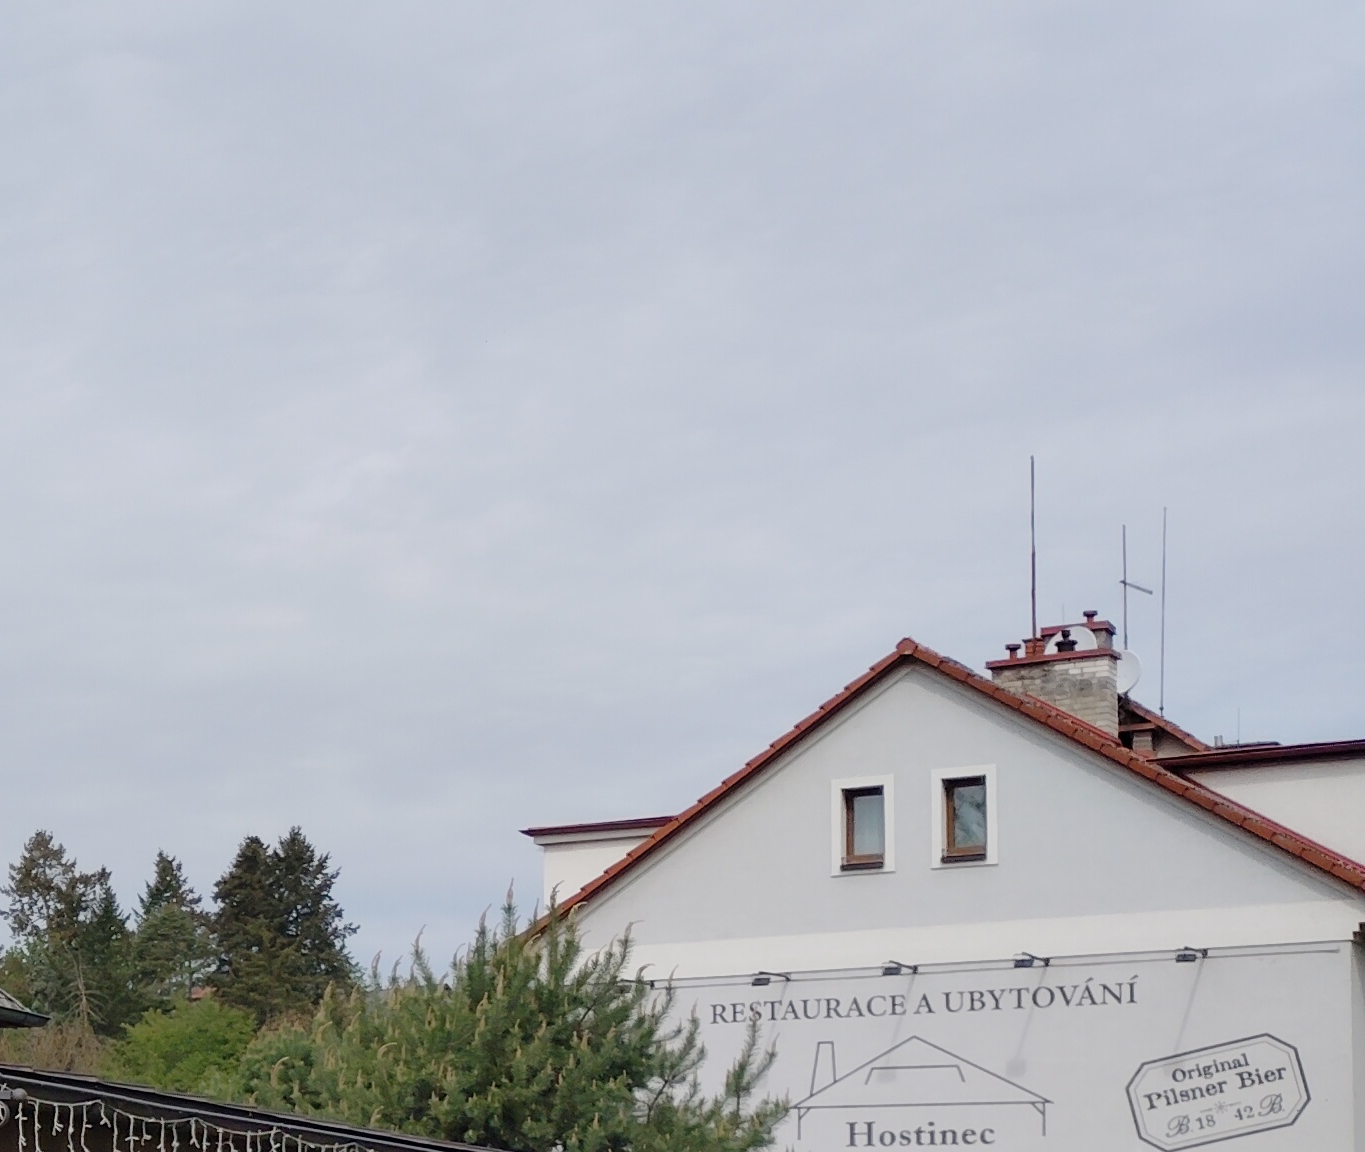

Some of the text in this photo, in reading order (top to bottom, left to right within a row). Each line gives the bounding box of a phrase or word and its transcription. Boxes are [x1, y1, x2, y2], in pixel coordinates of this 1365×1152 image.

[710, 975, 1139, 1025] RESTAURACE A UBYTOVÁNÍ
[1172, 1053, 1250, 1083] Original
[1143, 1067, 1287, 1111] Pilsner Bier
[845, 1121, 996, 1148] Hostinec
